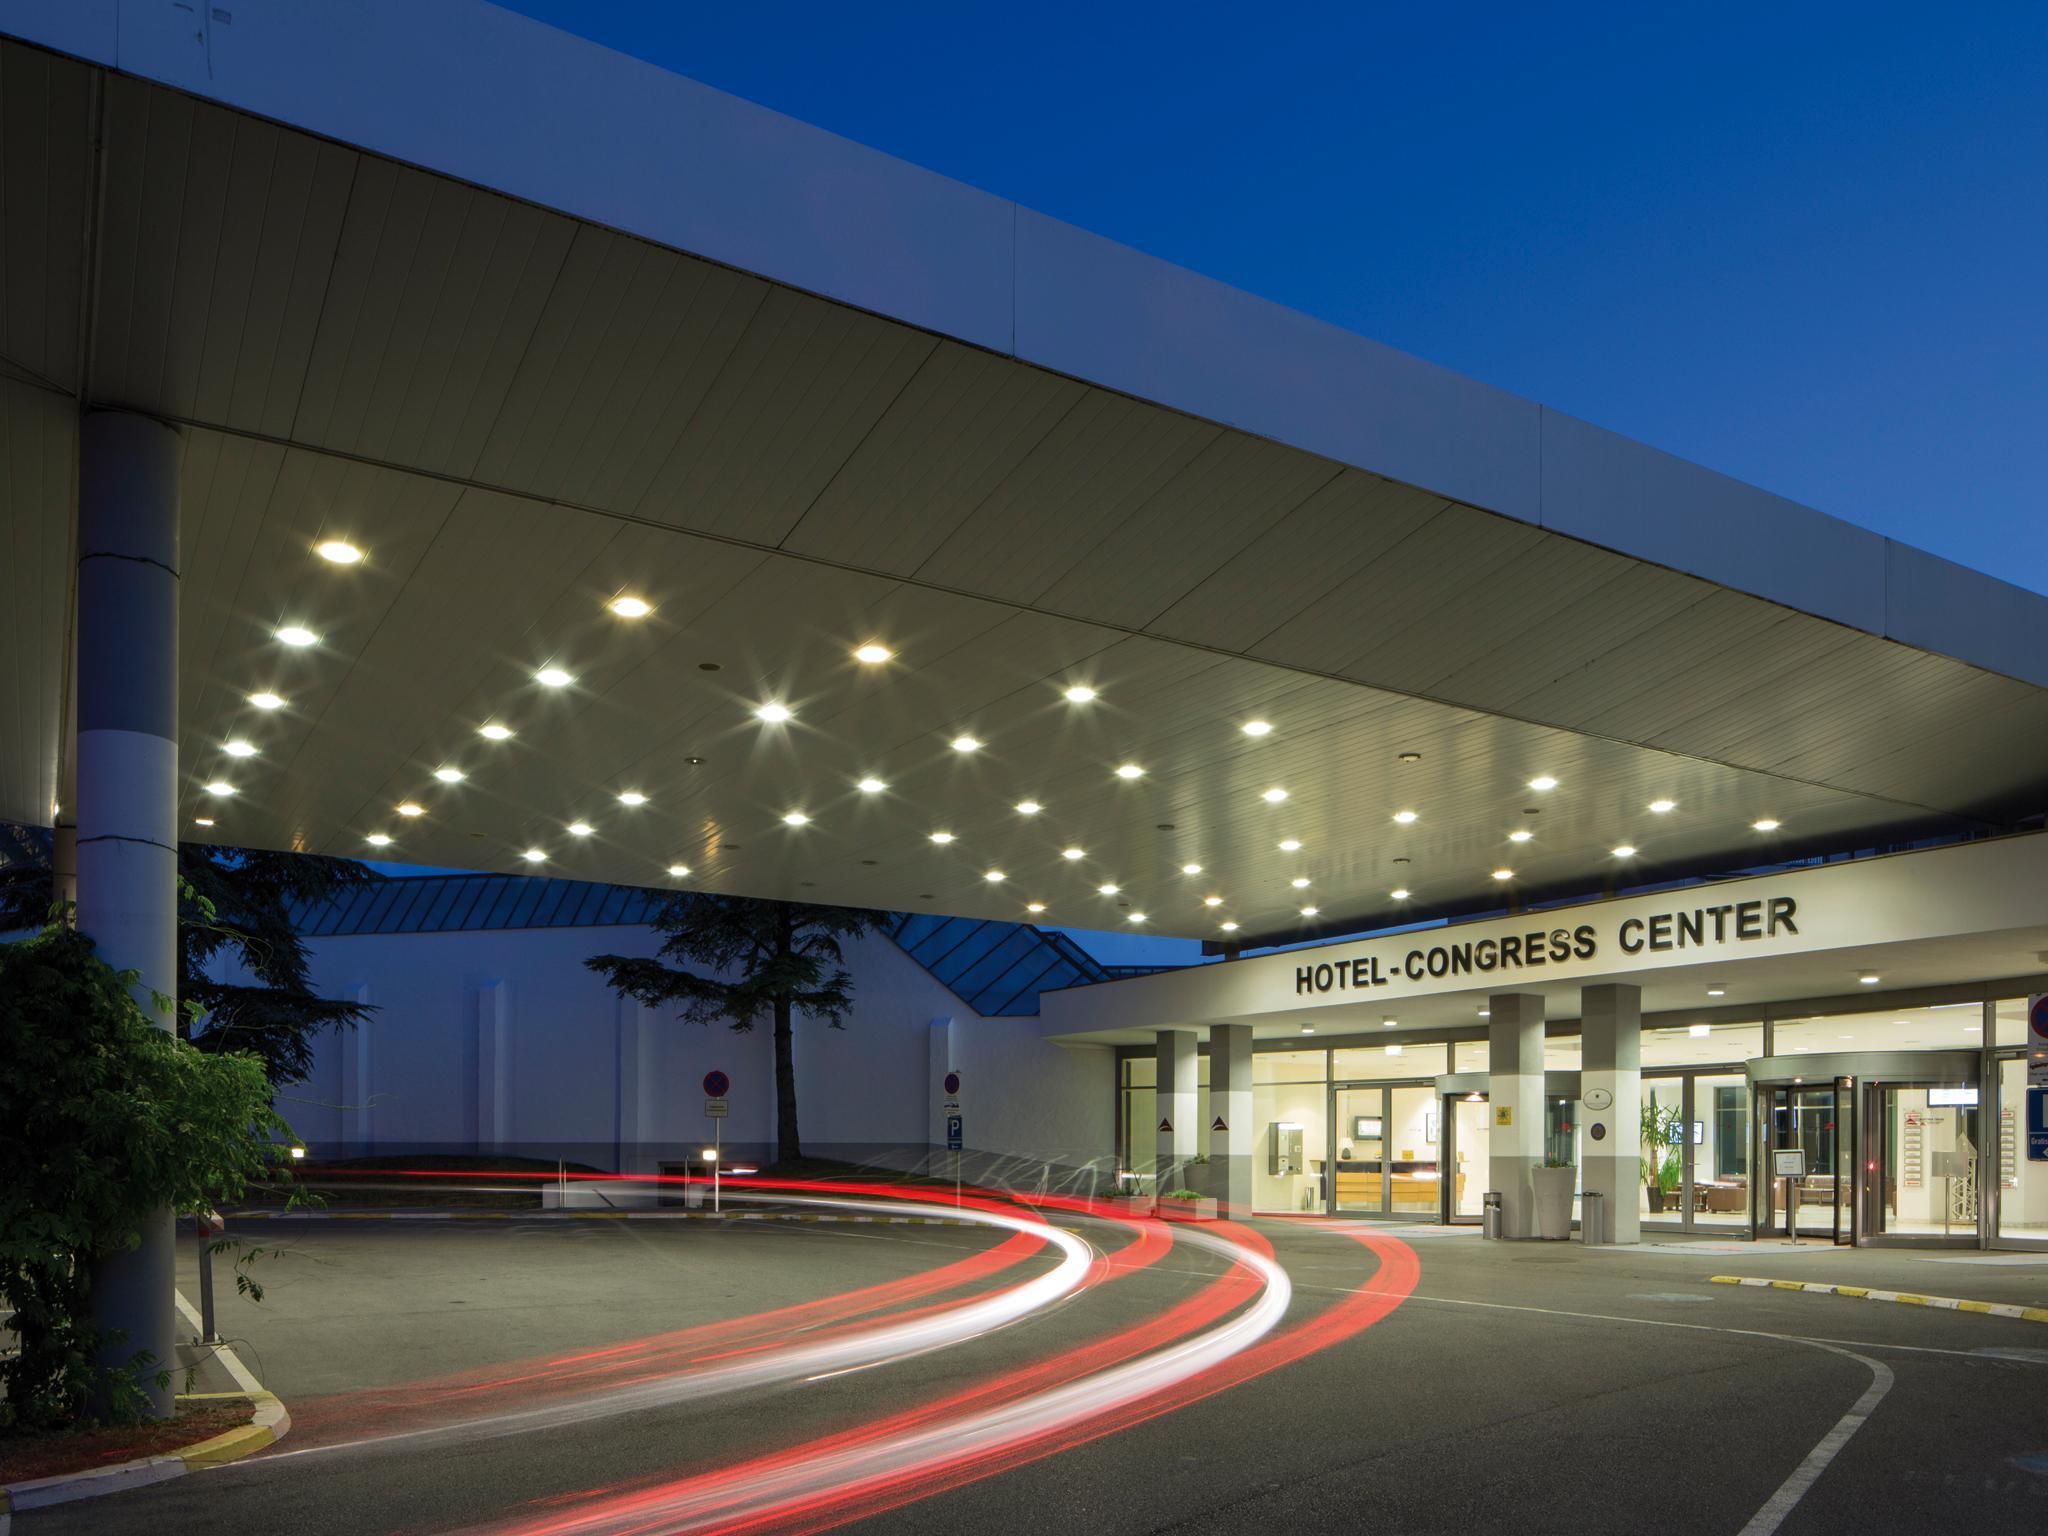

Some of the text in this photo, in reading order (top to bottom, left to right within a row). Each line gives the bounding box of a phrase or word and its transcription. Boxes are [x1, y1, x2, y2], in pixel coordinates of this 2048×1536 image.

[1296, 897, 1798, 994] HOTEL-CONGRESS CENTER
[951, 1119, 960, 1136] P
